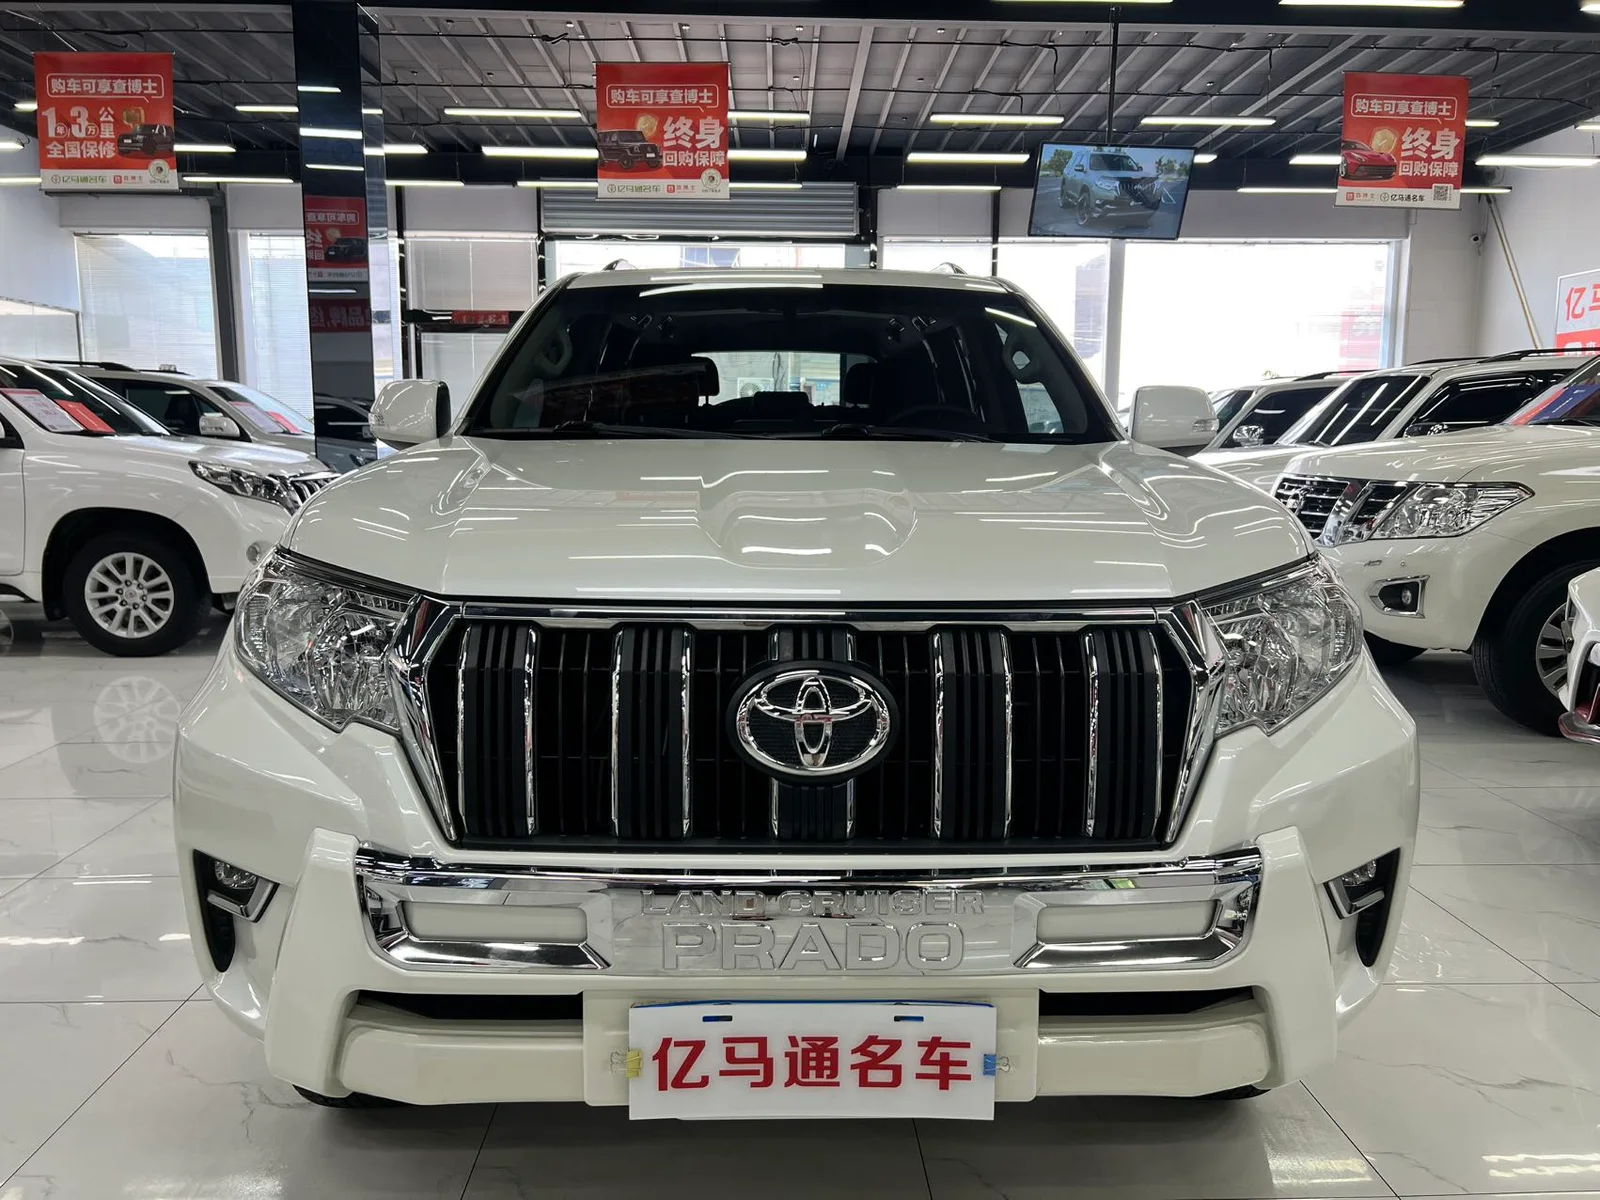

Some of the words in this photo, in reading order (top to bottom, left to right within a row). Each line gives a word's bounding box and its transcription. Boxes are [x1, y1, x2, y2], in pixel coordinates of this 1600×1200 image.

[51, 78, 158, 94] 购车可享查博士
[610, 88, 713, 105] 购车可享查博士
[1355, 98, 1452, 116] 购车可享查博士
[662, 115, 725, 149] 终身
[46, 141, 116, 159] 全国保修
[1400, 126, 1461, 160] 终身
[662, 150, 725, 167] 回购保障
[1398, 160, 1459, 178] 回购保障
[1390, 193, 1426, 202] 亿马通名车
[640, 888, 767, 916] LAND
[778, 888, 985, 916] CRUISER
[661, 920, 965, 971] PRADO
[652, 1035, 972, 1092] 亿马通名车
